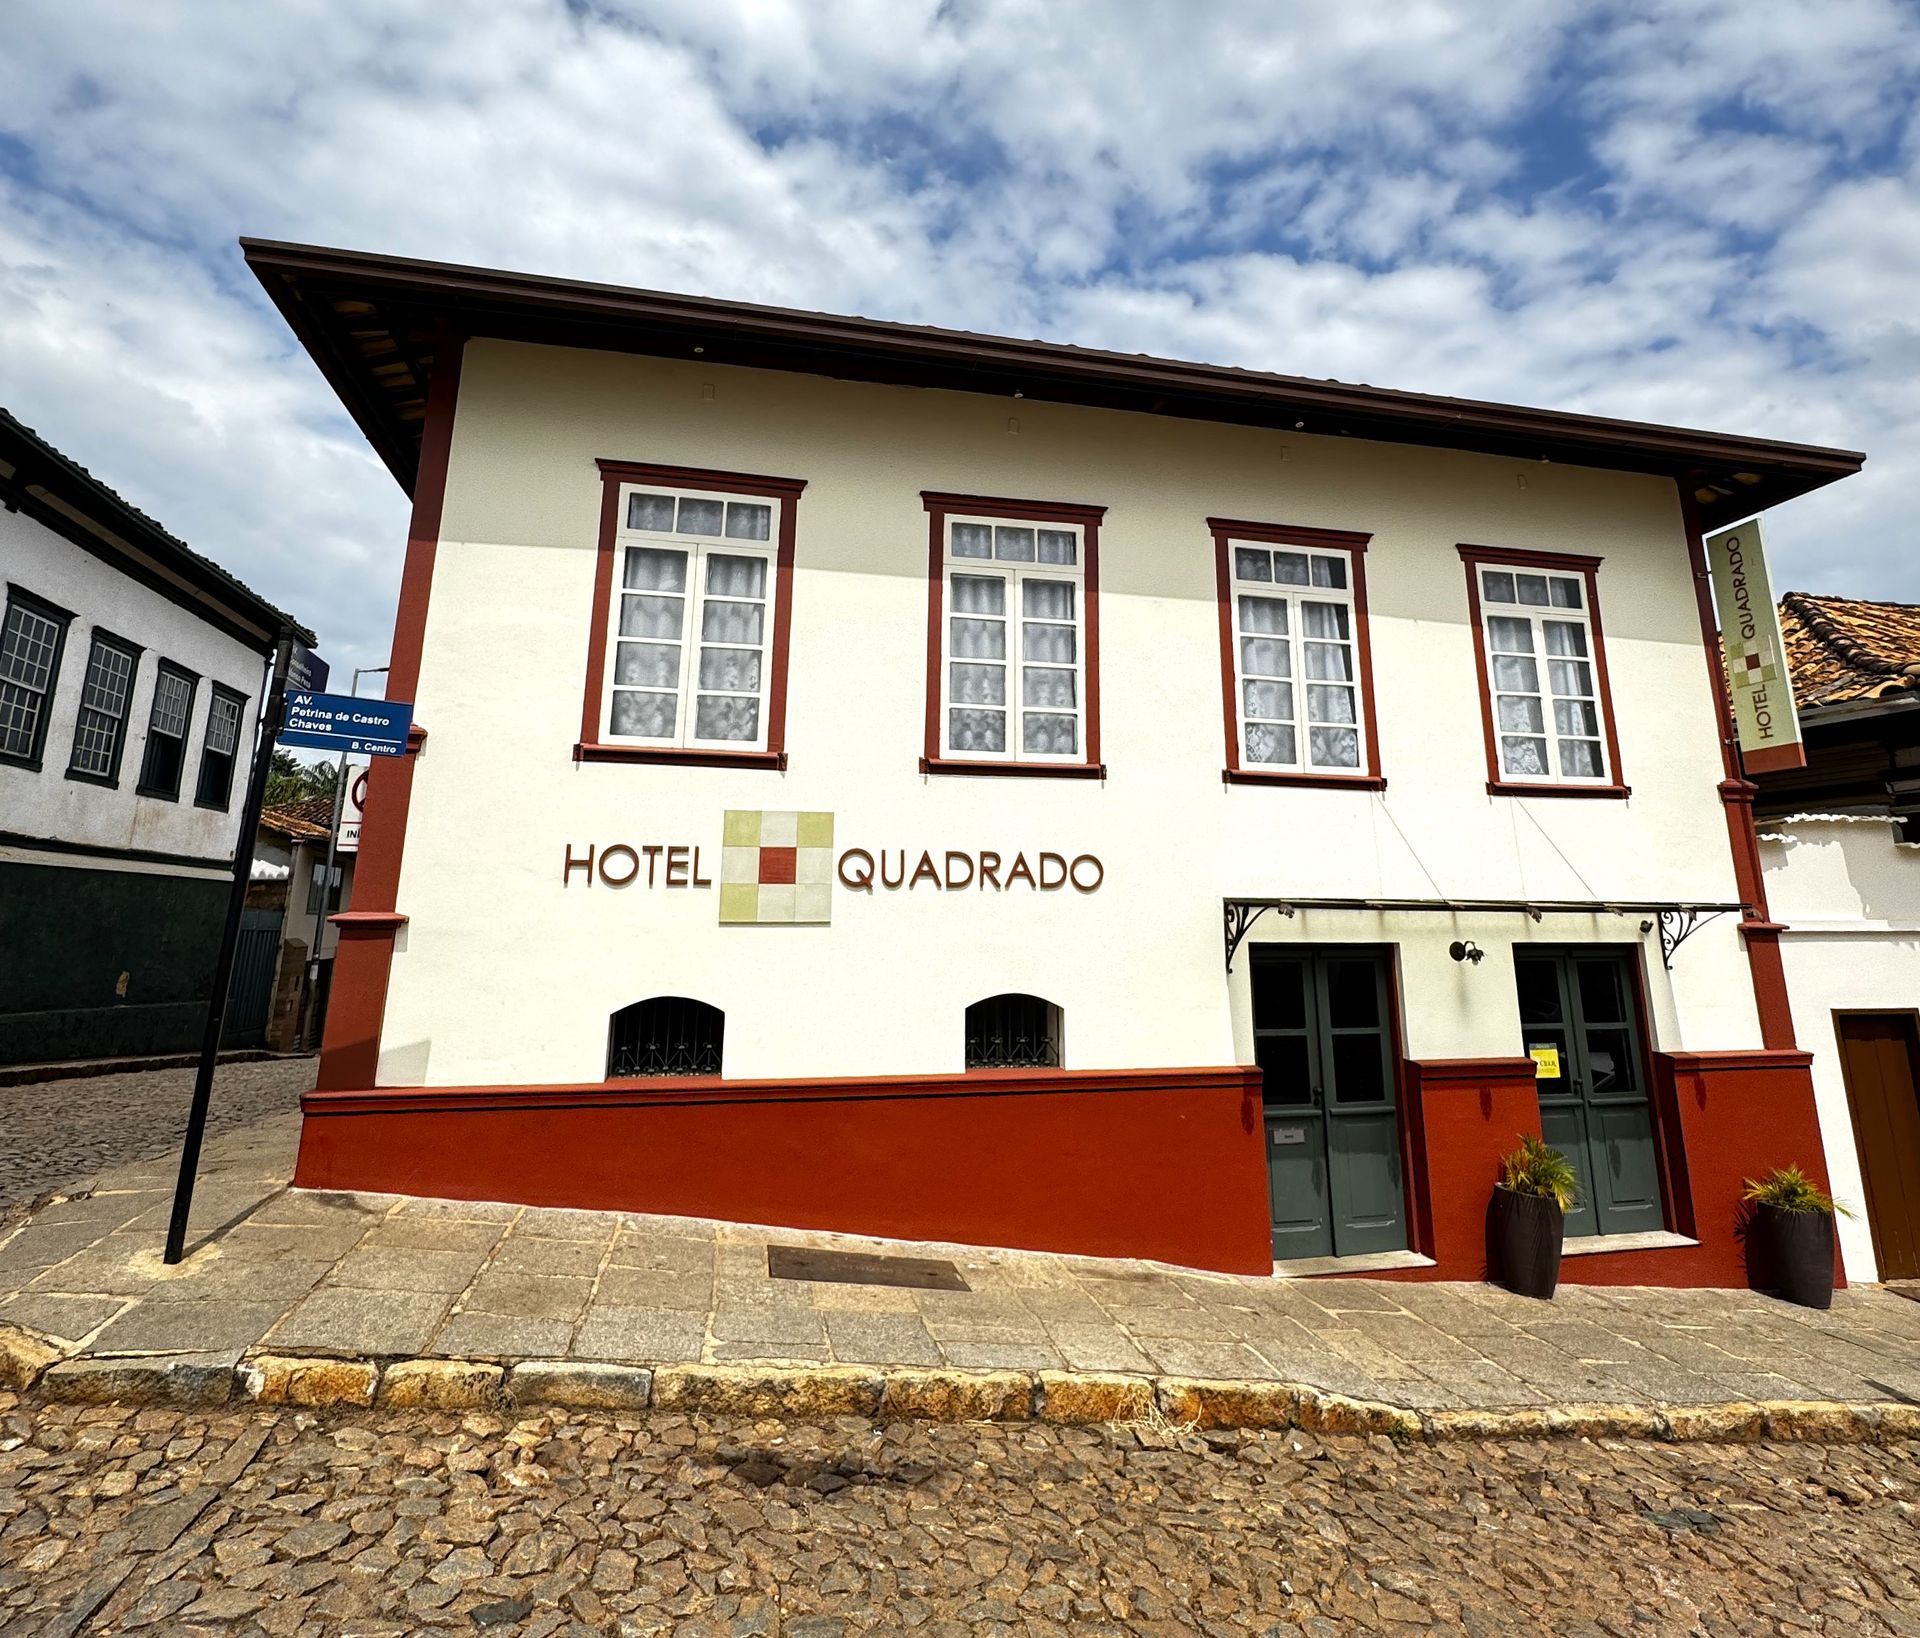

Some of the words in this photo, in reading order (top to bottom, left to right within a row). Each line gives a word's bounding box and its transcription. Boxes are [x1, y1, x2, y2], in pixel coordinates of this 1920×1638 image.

[1726, 536, 1756, 640] QUADRADO
[294, 695, 313, 705] AV.
[291, 706, 333, 720] Petrina
[335, 711, 350, 722] de
[352, 713, 390, 726] Castro
[1751, 684, 1774, 740] HOTEL
[289, 718, 332, 731] Chaves
[351, 741, 362, 750] B.
[364, 742, 397, 754] Centro
[563, 843, 712, 887] HOTEL
[837, 847, 1105, 893] QUADRADO
